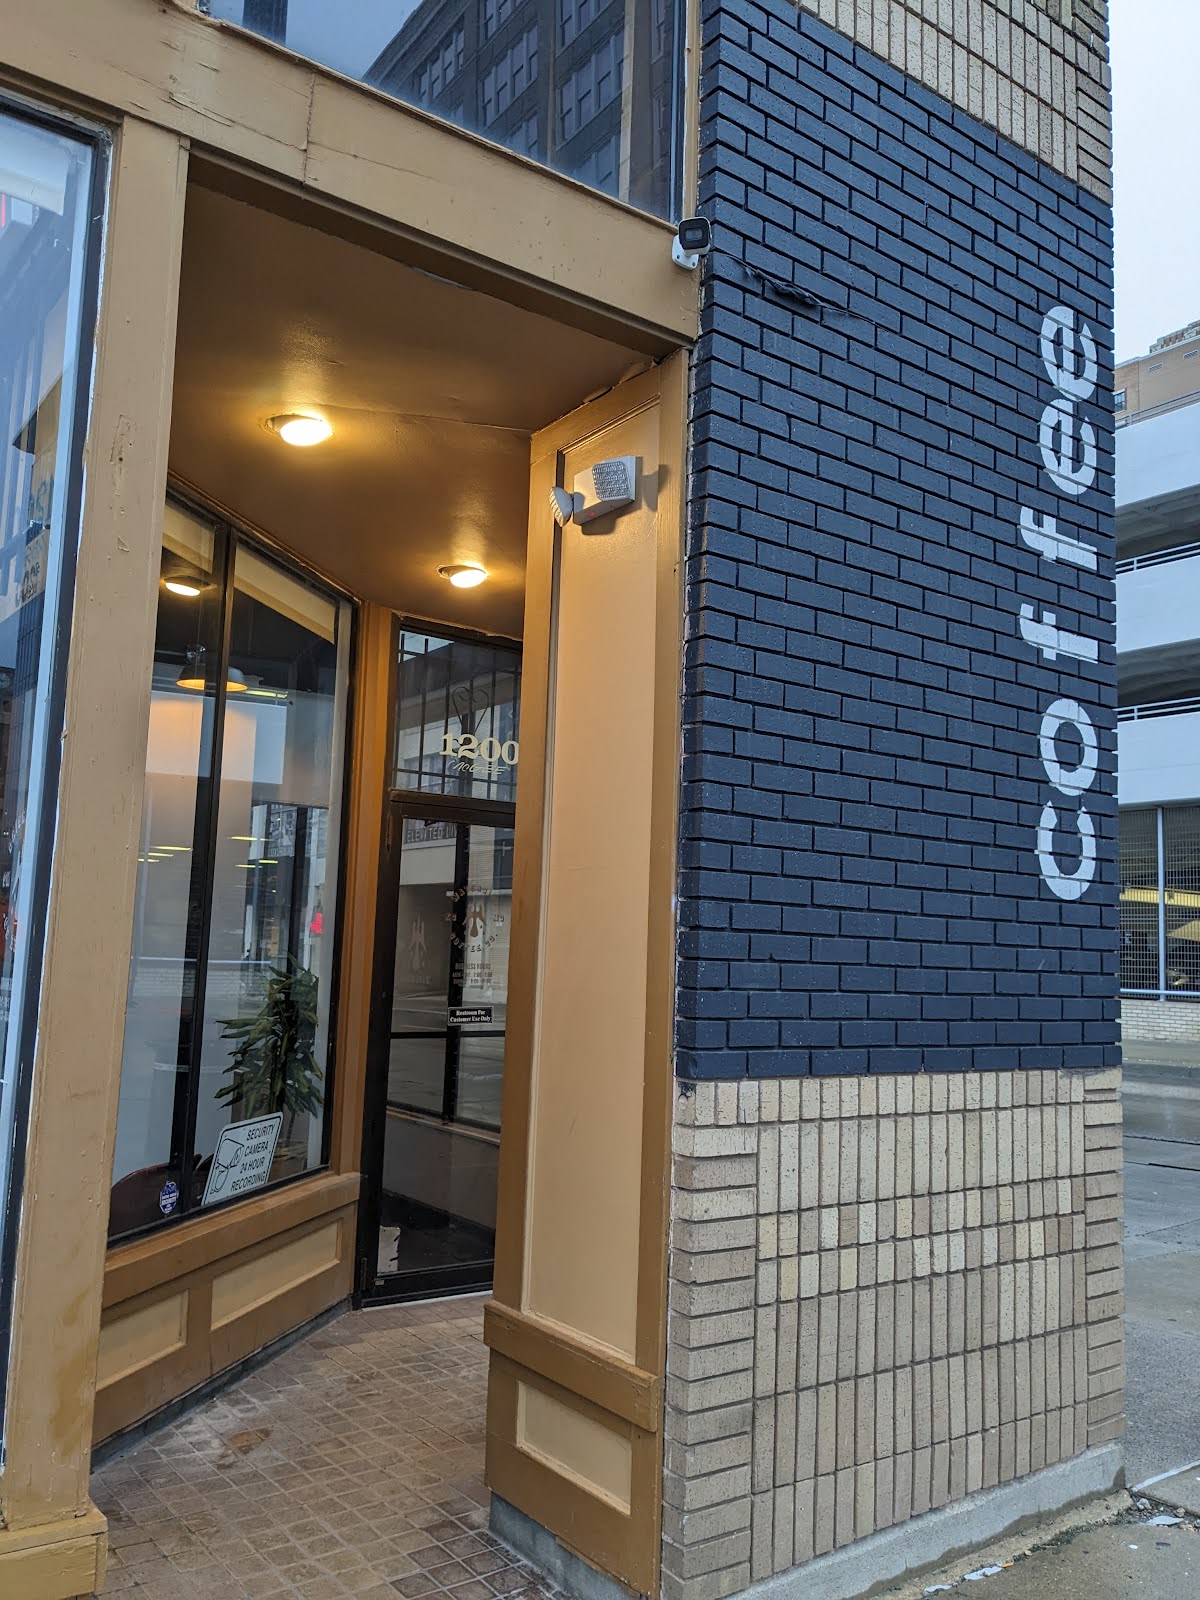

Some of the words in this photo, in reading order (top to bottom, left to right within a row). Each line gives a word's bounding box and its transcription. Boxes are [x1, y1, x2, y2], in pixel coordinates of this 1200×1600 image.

[439, 732, 519, 765] 1200
[246, 1124, 275, 1141] SECURITY
[244, 1141, 269, 1157] CAMERA
[239, 1162, 247, 1173] 24
[247, 1156, 266, 1171] HOUR
[231, 1171, 266, 1191] RECORDING
